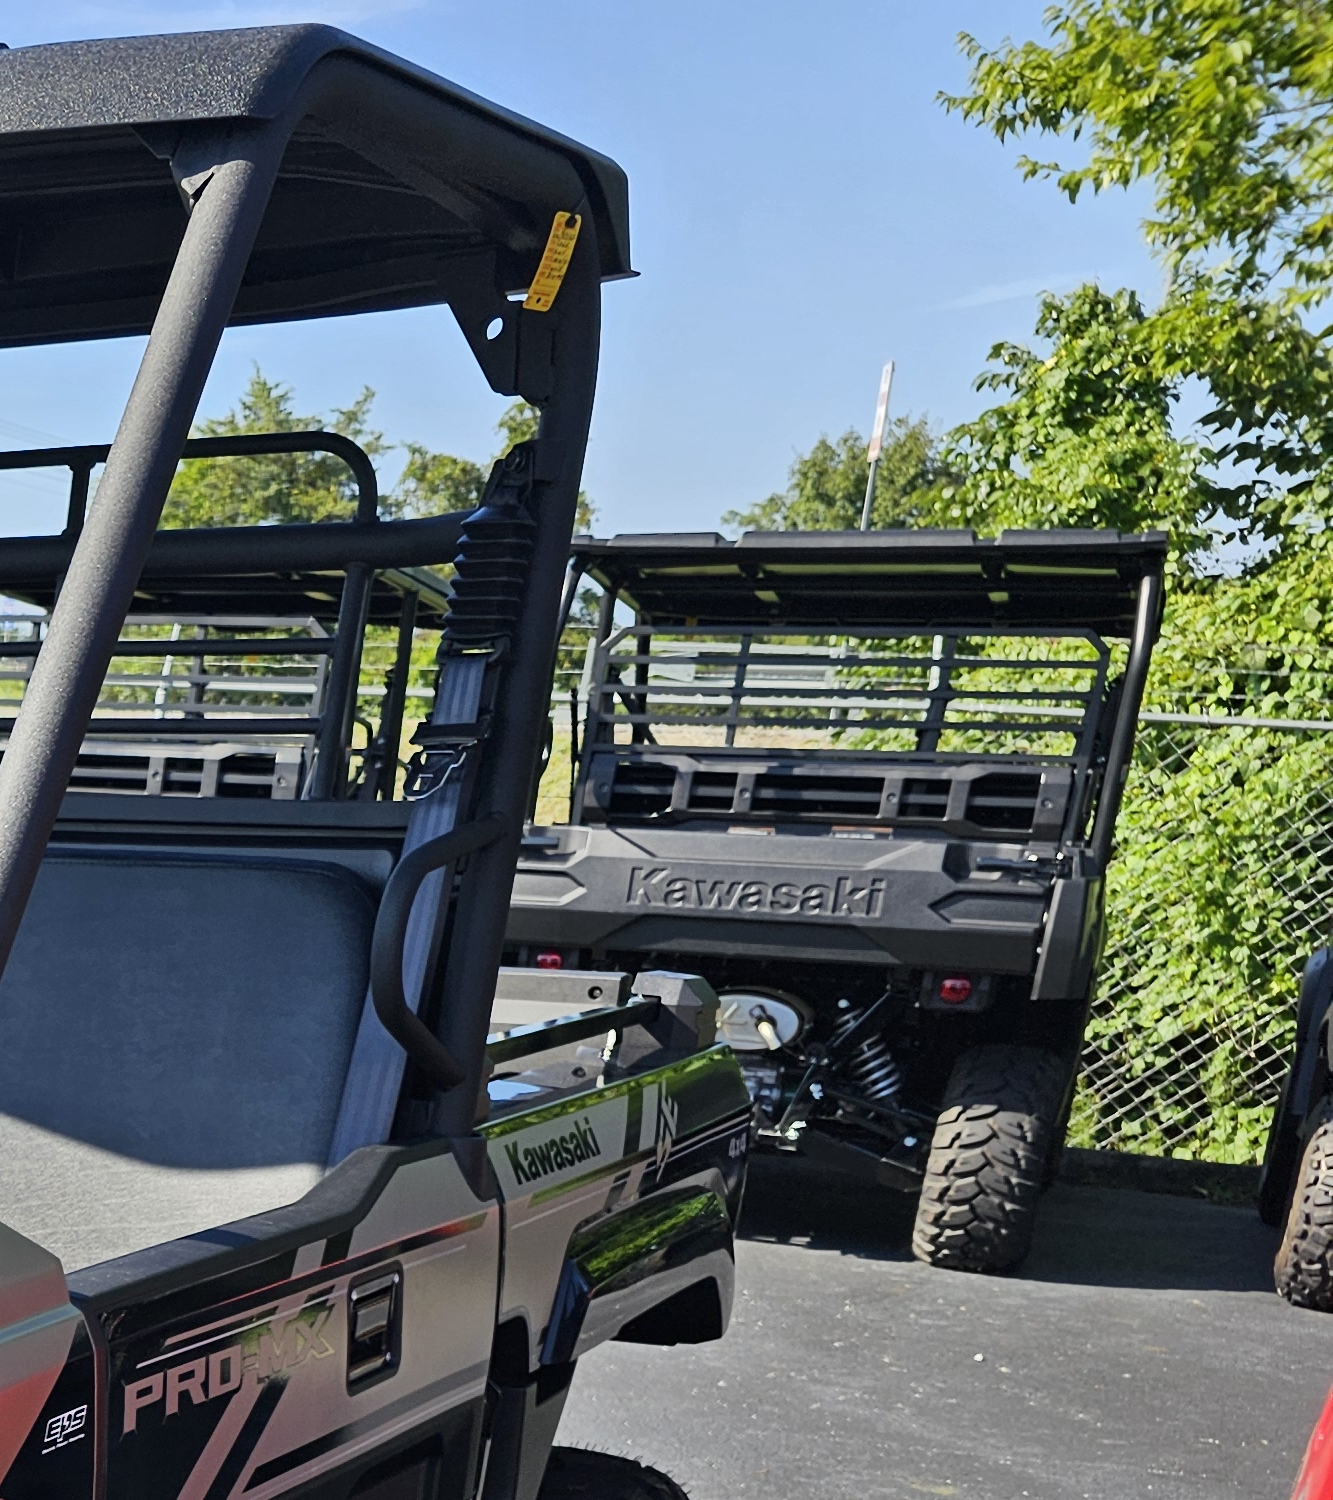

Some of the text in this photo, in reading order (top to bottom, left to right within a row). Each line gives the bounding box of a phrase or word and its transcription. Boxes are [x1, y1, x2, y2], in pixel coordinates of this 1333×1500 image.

[626, 867, 886, 918] Kawasaki
[504, 1117, 601, 1185] Kawasaki
[121, 1304, 336, 1435] PRO-MX
